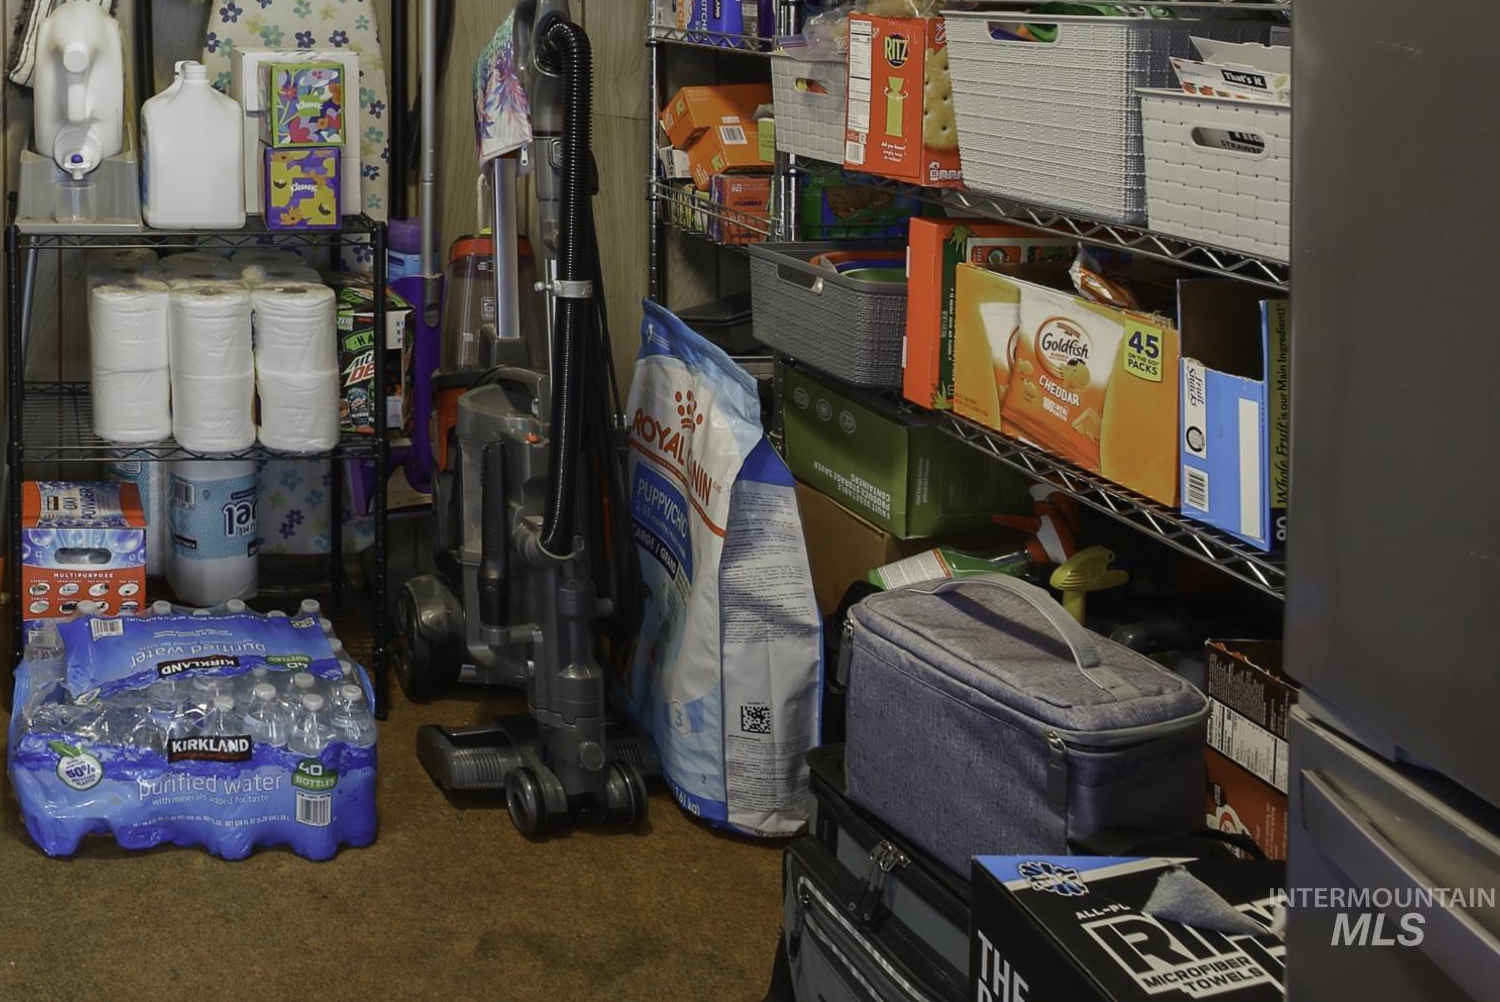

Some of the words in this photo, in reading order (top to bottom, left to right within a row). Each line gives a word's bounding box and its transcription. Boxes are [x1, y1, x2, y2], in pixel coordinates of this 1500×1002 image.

[884, 36, 909, 62] RITZ
[1223, 71, 1253, 84] That's
[296, 101, 323, 110] Kleenex
[290, 181, 318, 193] Kleenex
[1042, 333, 1088, 359] Goldfish
[1128, 331, 1159, 358] 45
[350, 364, 374, 382] DE
[1128, 359, 1158, 375] PACKS
[1277, 365, 1287, 391] Main
[1039, 375, 1080, 406] CHEDDAR
[1188, 368, 1197, 406] Snacks
[1195, 376, 1204, 405] Fruit
[1278, 412, 1287, 420] is
[633, 407, 685, 466] ROYAL
[1276, 420, 1288, 456] Fruit
[1275, 460, 1288, 504] Whole
[63, 497, 78, 510] OXI
[80, 487, 96, 520] POWDER
[129, 647, 184, 669] water
[161, 659, 235, 674] KIRKLAND
[172, 739, 250, 753] KIRKLAND
[137, 774, 217, 801] purified
[224, 775, 283, 794] water
[295, 775, 336, 788] BOTTLES
[152, 796, 170, 806] with
[1141, 955, 1254, 988] MICROFIBER
[1182, 966, 1265, 992] TOWELS
